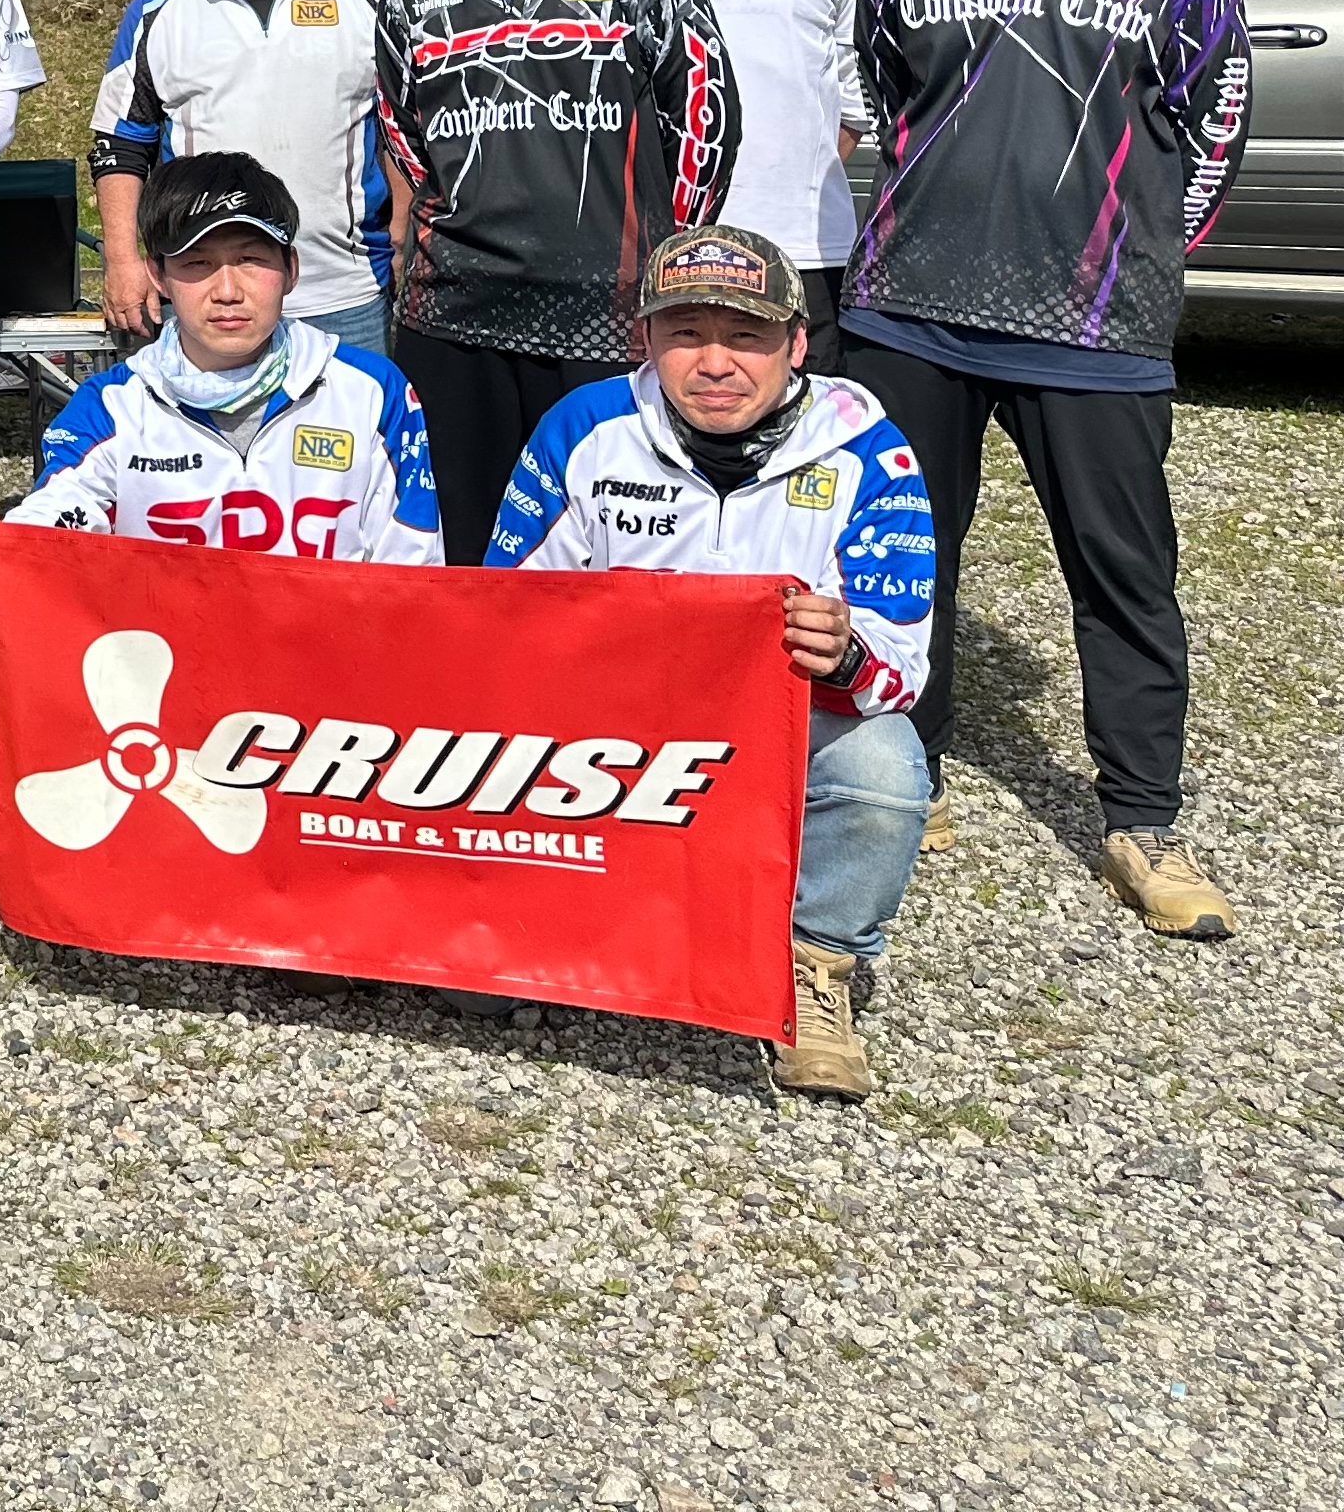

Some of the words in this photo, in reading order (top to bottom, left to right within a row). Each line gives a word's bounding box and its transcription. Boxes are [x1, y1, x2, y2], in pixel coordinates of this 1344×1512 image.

[297, 5, 334, 20] NBC
[414, 19, 635, 82] DECOY
[426, 94, 536, 141] Confident
[548, 90, 623, 133] Crew
[1201, 57, 1249, 143] Crew
[673, 22, 726, 231] ECOY
[664, 263, 759, 283] Megabass
[297, 434, 346, 461] NBC
[193, 709, 736, 827] CRUISE
[300, 810, 407, 842] BOAT
[415, 826, 444, 848] &
[453, 827, 604, 862] TACKLE
